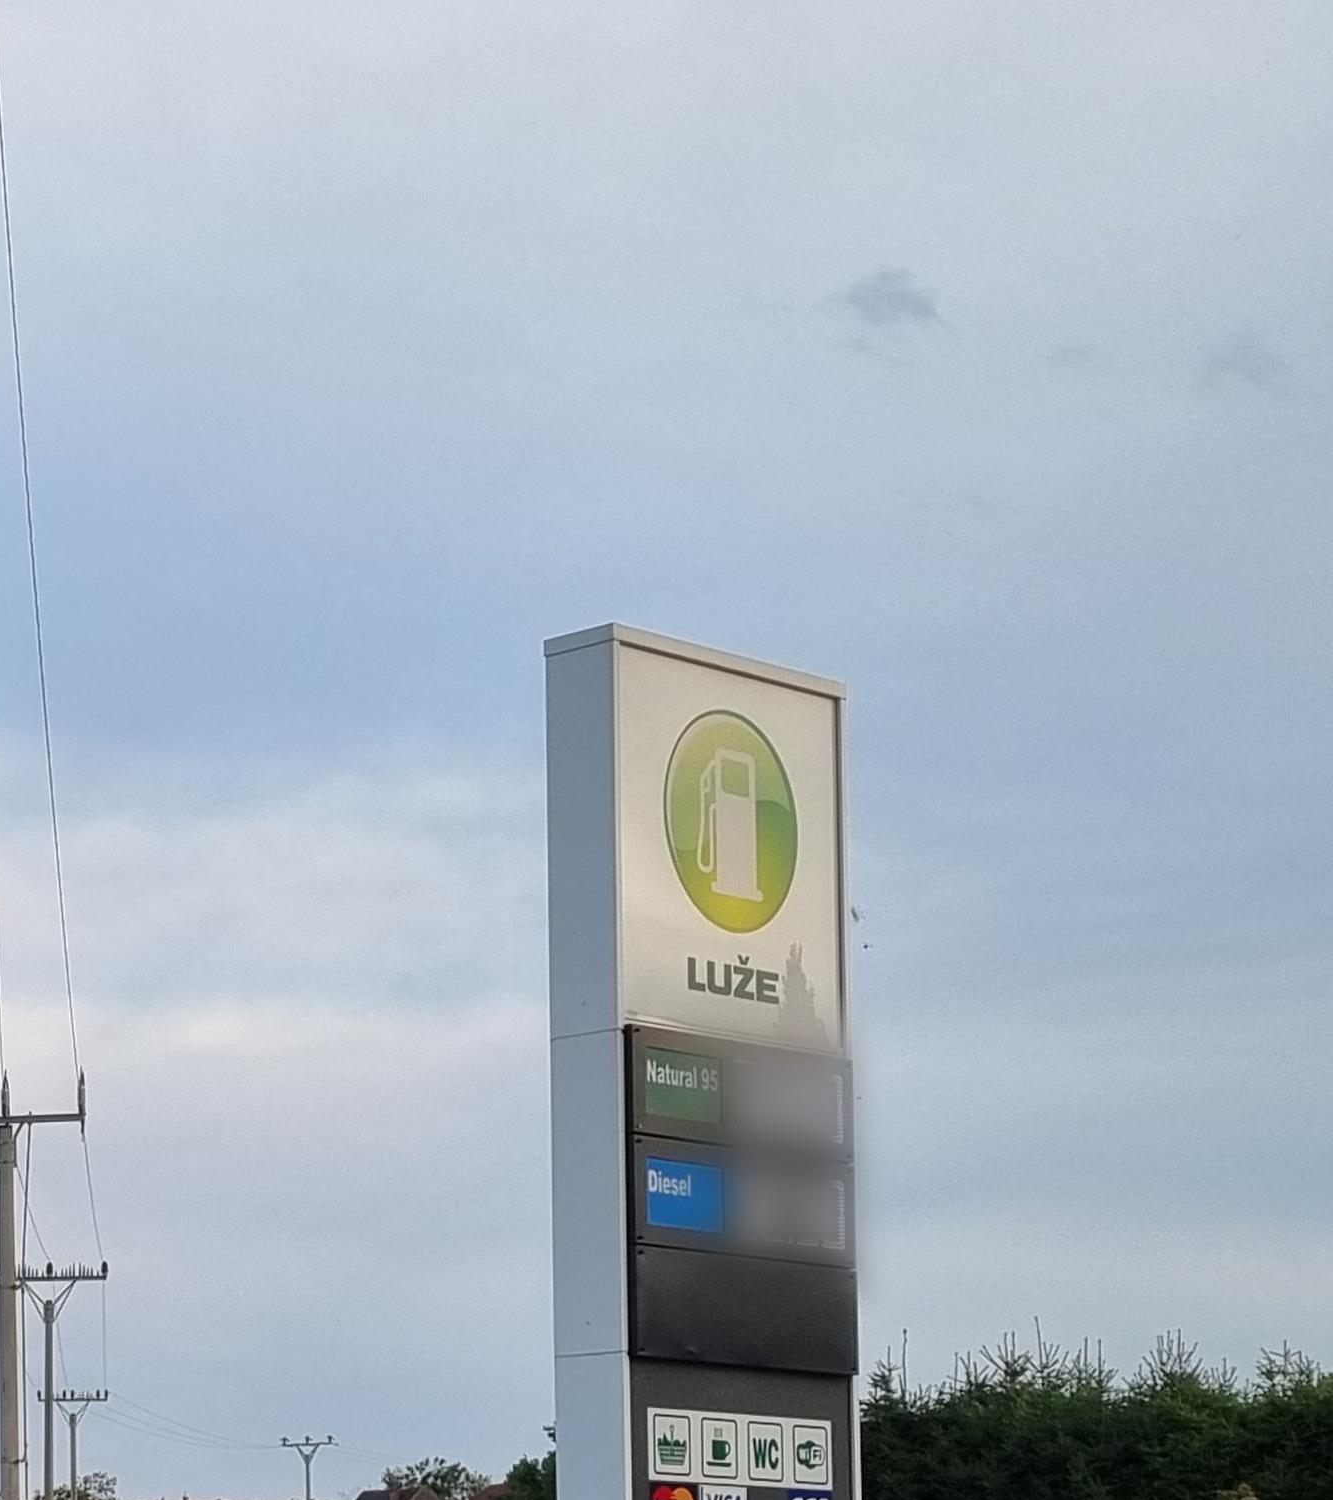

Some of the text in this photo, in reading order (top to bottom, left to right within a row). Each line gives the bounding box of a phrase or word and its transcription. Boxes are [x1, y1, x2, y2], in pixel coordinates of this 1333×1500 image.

[687, 954, 780, 1004] LUŽE
[646, 1059, 719, 1092] Natural 95
[647, 1169, 692, 1197] Diesel
[752, 1437, 779, 1470] WC
